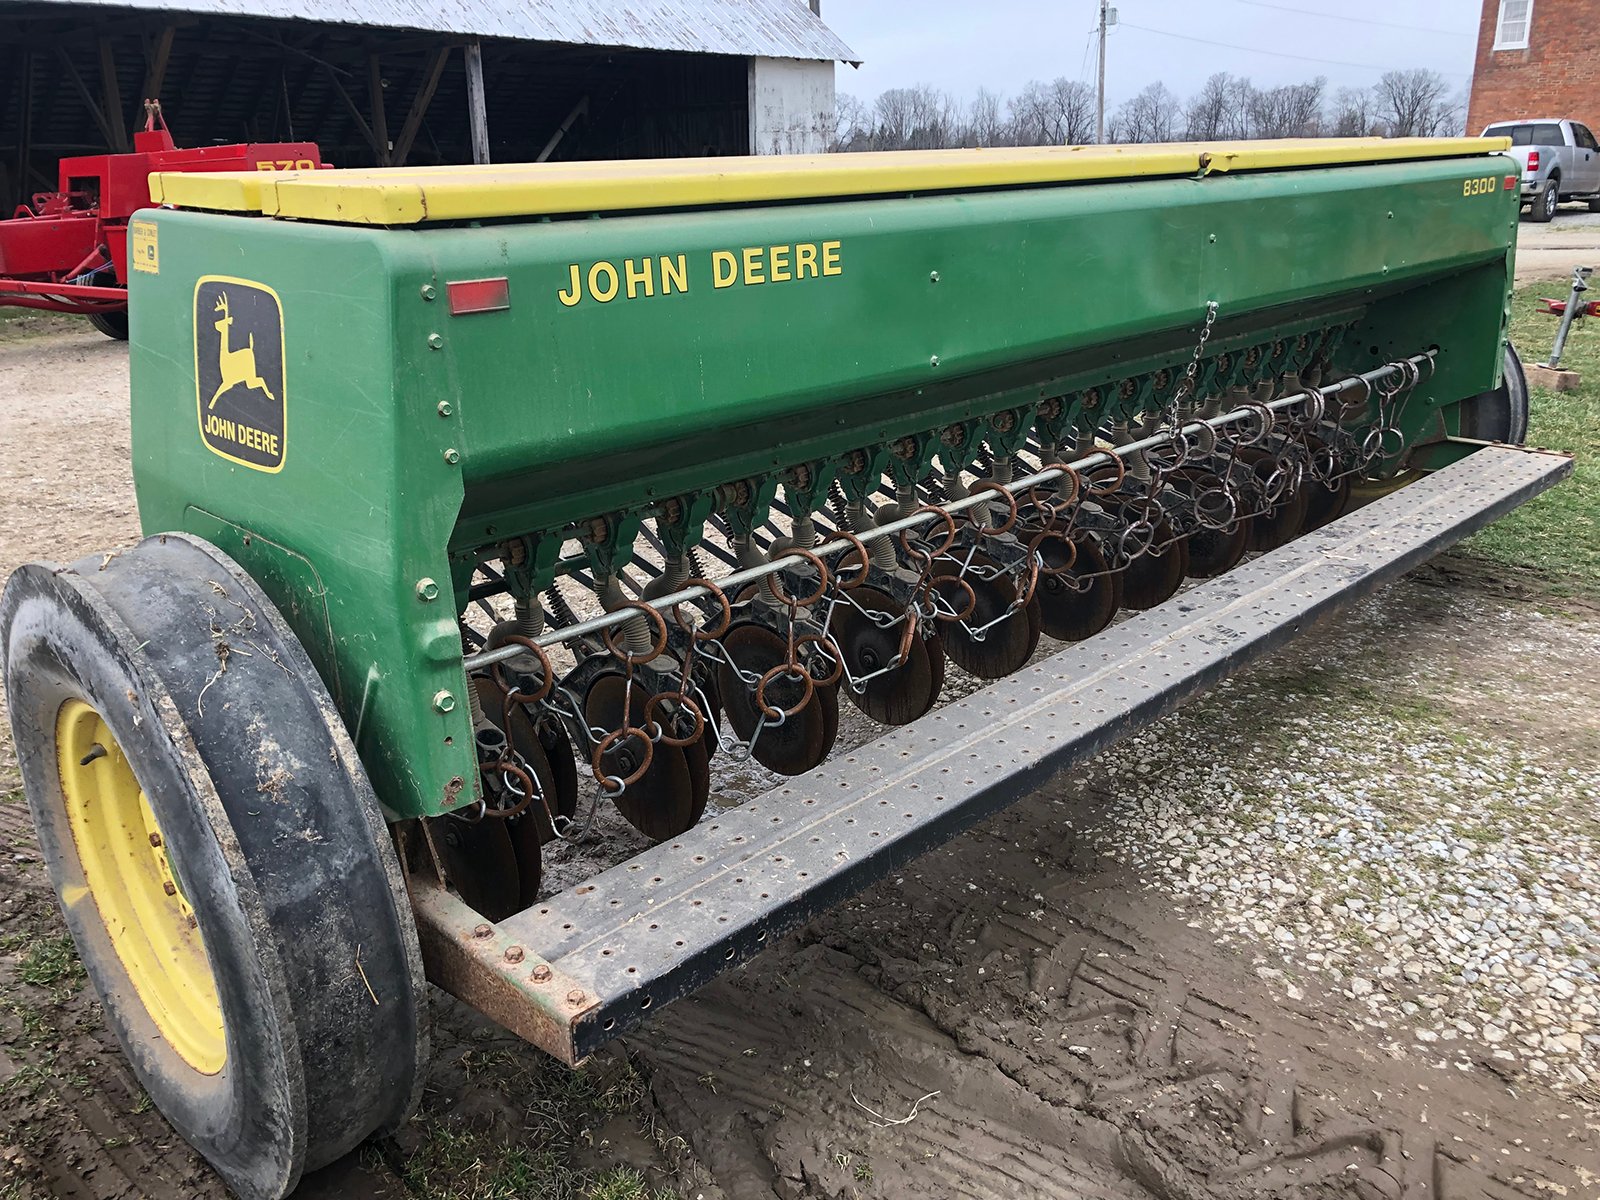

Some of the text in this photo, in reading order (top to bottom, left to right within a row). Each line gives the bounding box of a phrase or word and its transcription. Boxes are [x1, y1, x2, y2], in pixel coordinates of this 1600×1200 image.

[1463, 176, 1496, 197] 8300
[558, 240, 842, 307] JOHN DEERE
[205, 414, 279, 456] JOHN DEERE
